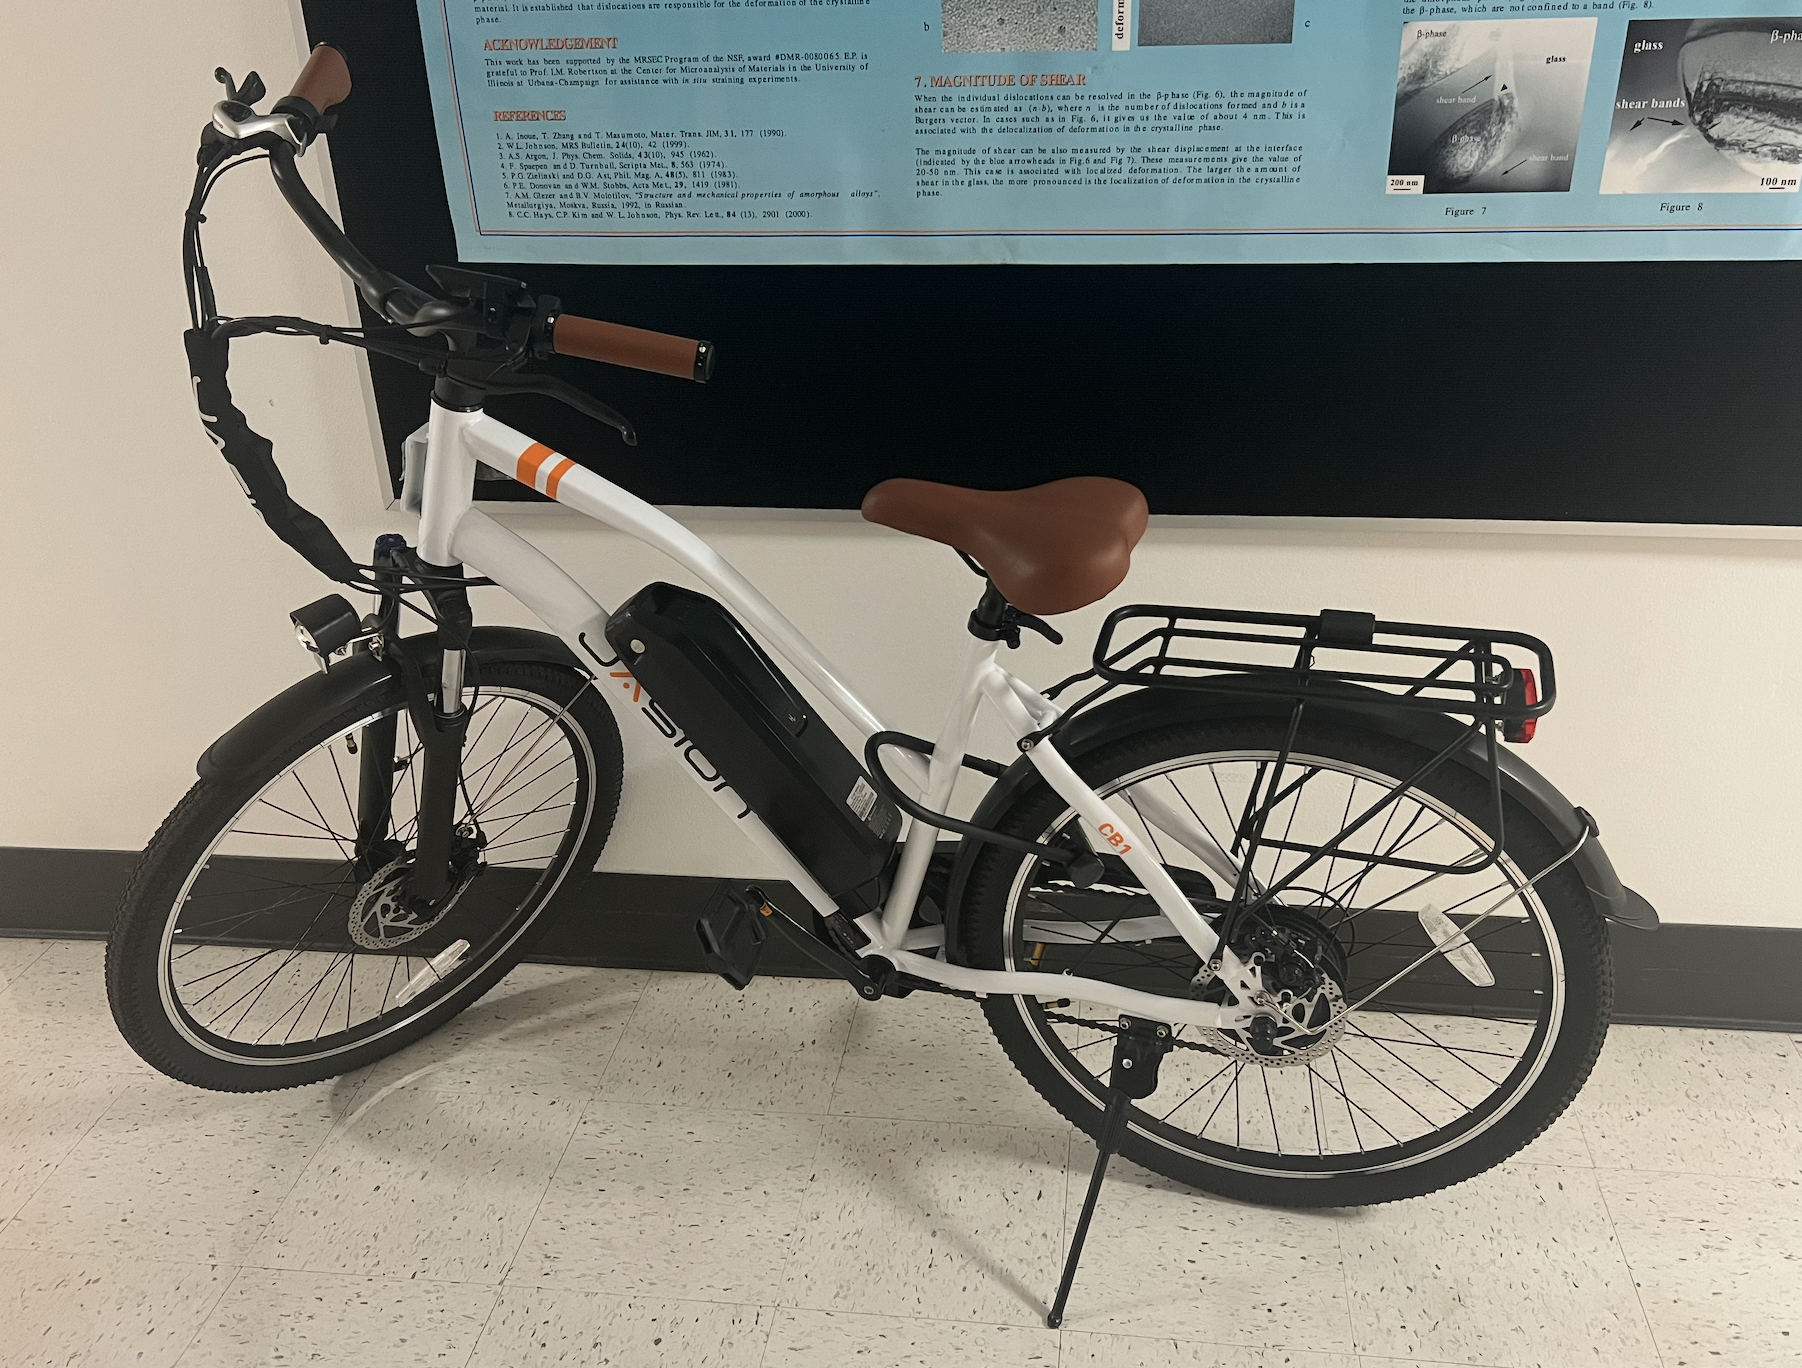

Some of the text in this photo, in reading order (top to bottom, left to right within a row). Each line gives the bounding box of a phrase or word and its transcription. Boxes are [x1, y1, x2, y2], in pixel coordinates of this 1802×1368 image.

[1403, 6, 1414, 15] the
[1461, 4, 1486, 13] which
[1528, 3, 1568, 11] confined
[1592, 1, 1614, 9] band
[923, 22, 930, 32] b
[1304, 20, 1310, 28] c
[484, 37, 618, 51] ACKNOWLEDGEMENT
[1633, 40, 1664, 53] glass
[1545, 55, 1566, 65] glass
[930, 74, 1015, 87] MAGNITUDE
[1019, 74, 1038, 87] OF
[1040, 74, 1086, 86] SHEAR
[1436, 95, 1477, 104] shear band
[1615, 97, 1686, 109] shear bands
[494, 110, 566, 122] REFERENCES
[1528, 153, 1569, 161] shear band
[1760, 177, 1797, 186] 100 nm
[1445, 207, 1487, 217] Figure 7
[1659, 202, 1704, 213] Figure 8
[1098, 822, 1132, 855] CB1
